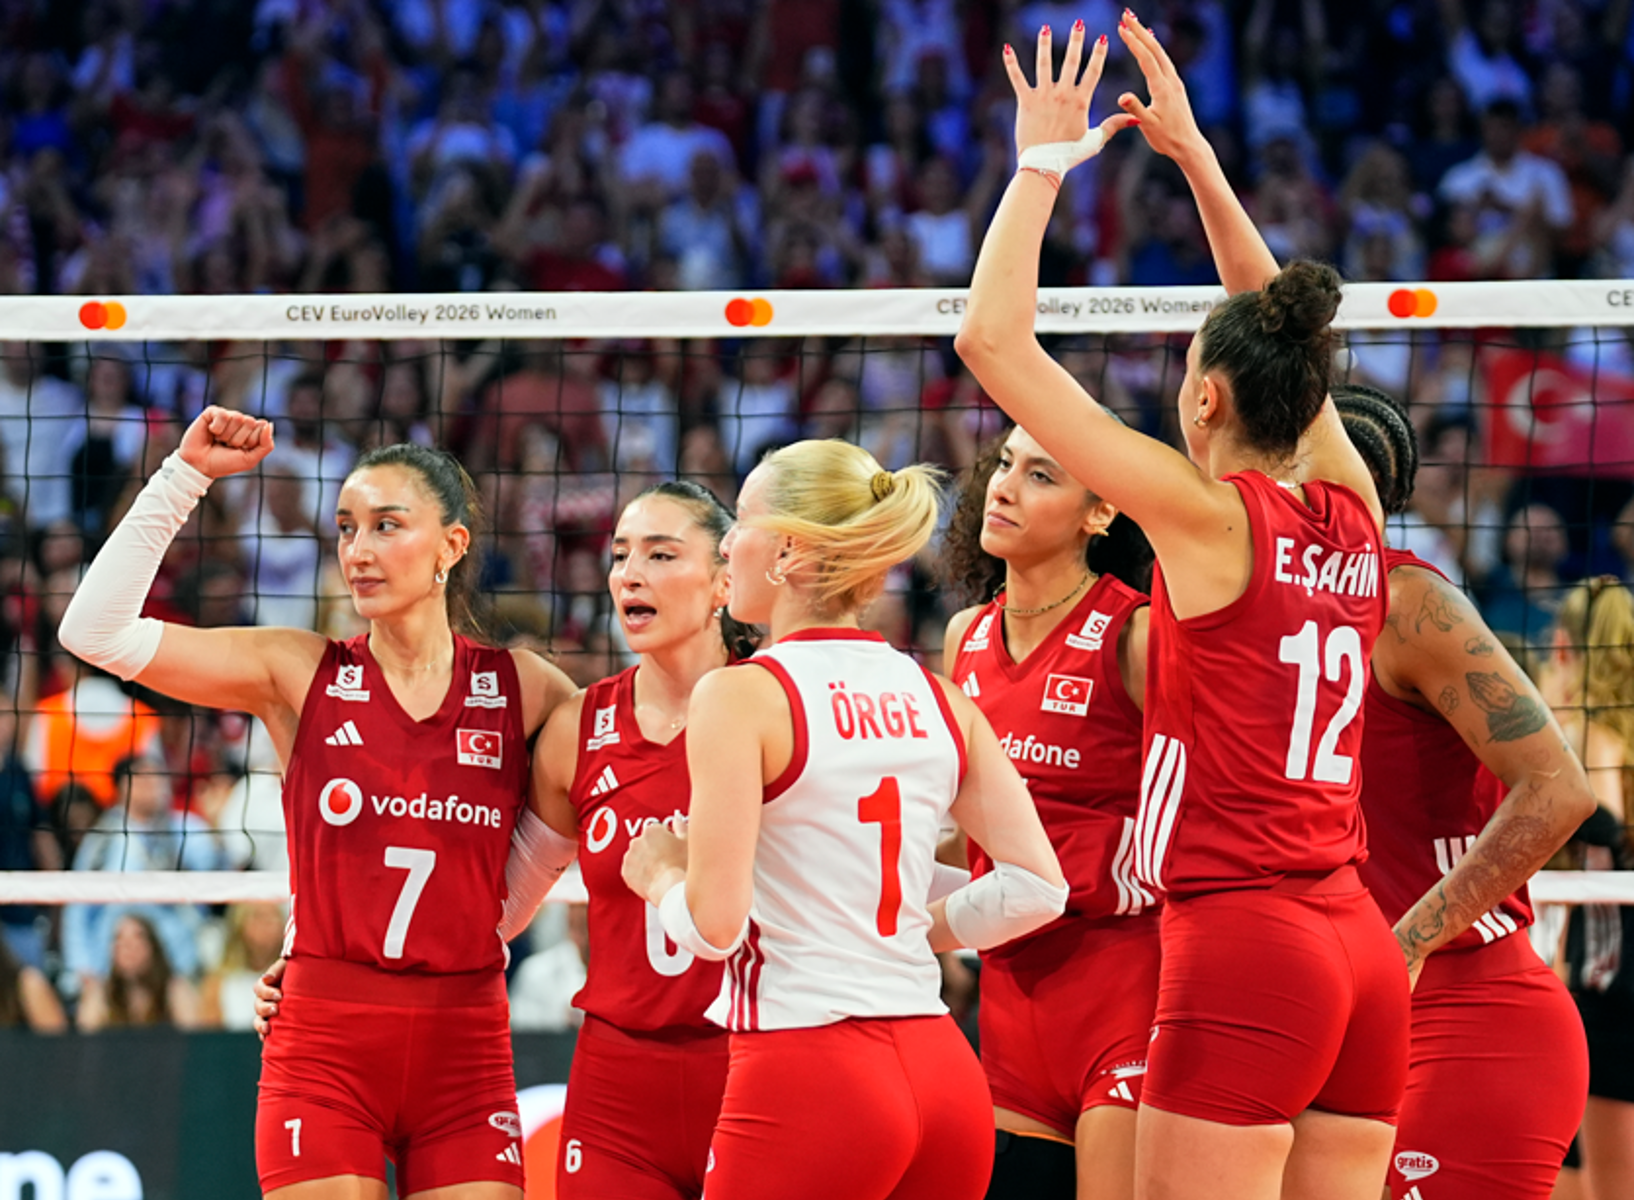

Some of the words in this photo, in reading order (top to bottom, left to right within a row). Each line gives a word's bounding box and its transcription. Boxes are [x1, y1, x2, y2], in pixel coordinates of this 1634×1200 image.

[286, 305, 325, 321] CEV
[331, 304, 429, 325] EuroVolley
[435, 304, 480, 320] 2026
[485, 304, 557, 320] Women
[1037, 296, 1082, 319] olley
[1089, 297, 1135, 314] 2026
[1141, 296, 1213, 313] Women
[1606, 290, 1634, 307] CE
[1275, 537, 1379, 598] E.ŞAHİN
[828, 681, 929, 740] ÖRGE
[1052, 702, 1077, 712] TUR
[1278, 620, 1365, 785] 12
[1000, 732, 1080, 769] dafone
[371, 793, 501, 828] vodafone
[857, 776, 903, 937] 1
[383, 846, 437, 959] 7
[565, 1139, 582, 1174] 6
[1397, 1156, 1433, 1170] gratis
